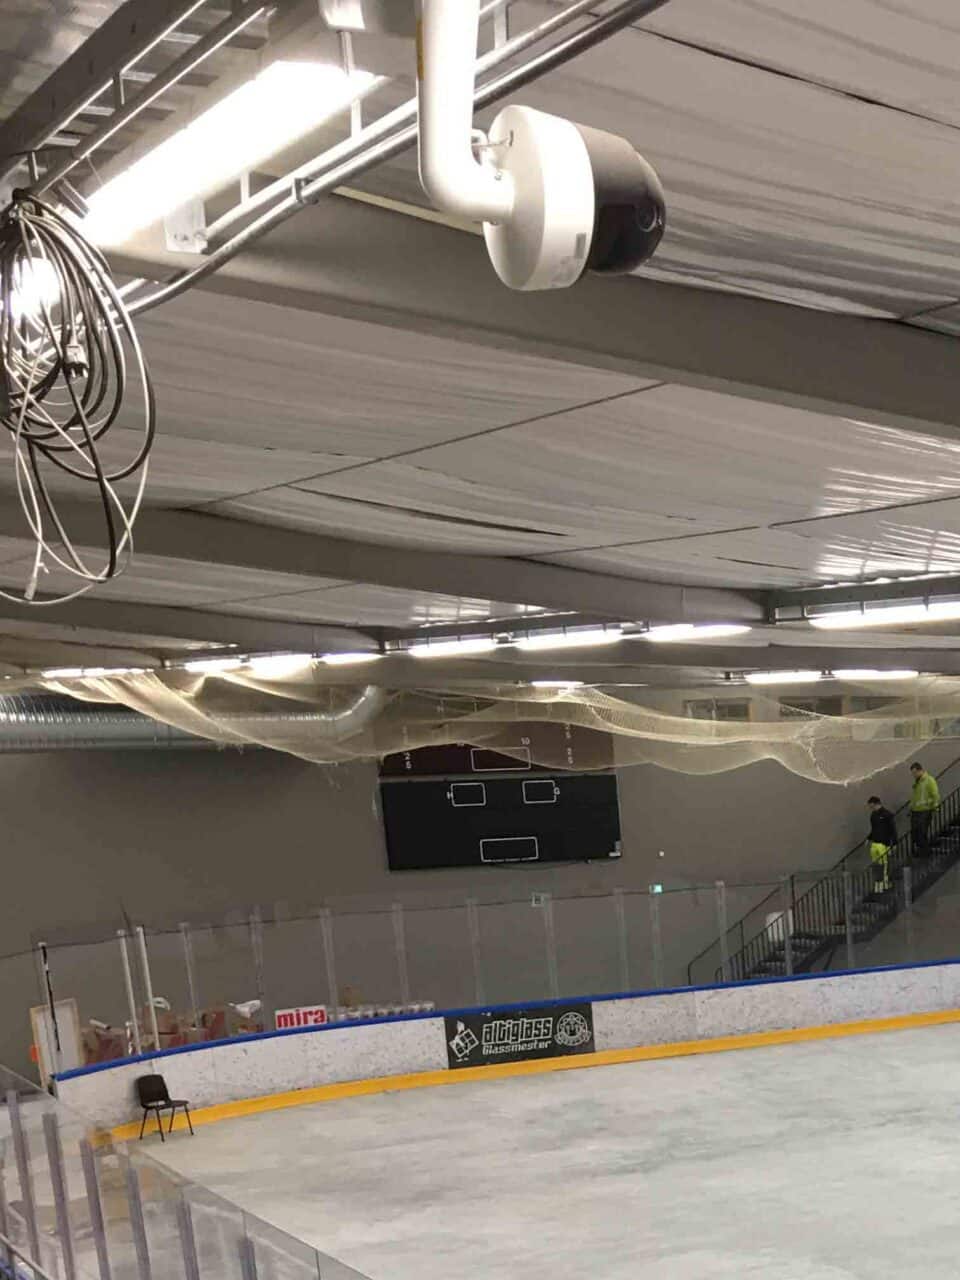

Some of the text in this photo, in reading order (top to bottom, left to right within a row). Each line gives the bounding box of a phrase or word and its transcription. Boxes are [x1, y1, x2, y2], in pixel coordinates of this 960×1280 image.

[276, 1008, 326, 1028] mira
[481, 1017, 553, 1045] altiglass
[482, 1040, 552, 1056] Glassmester
